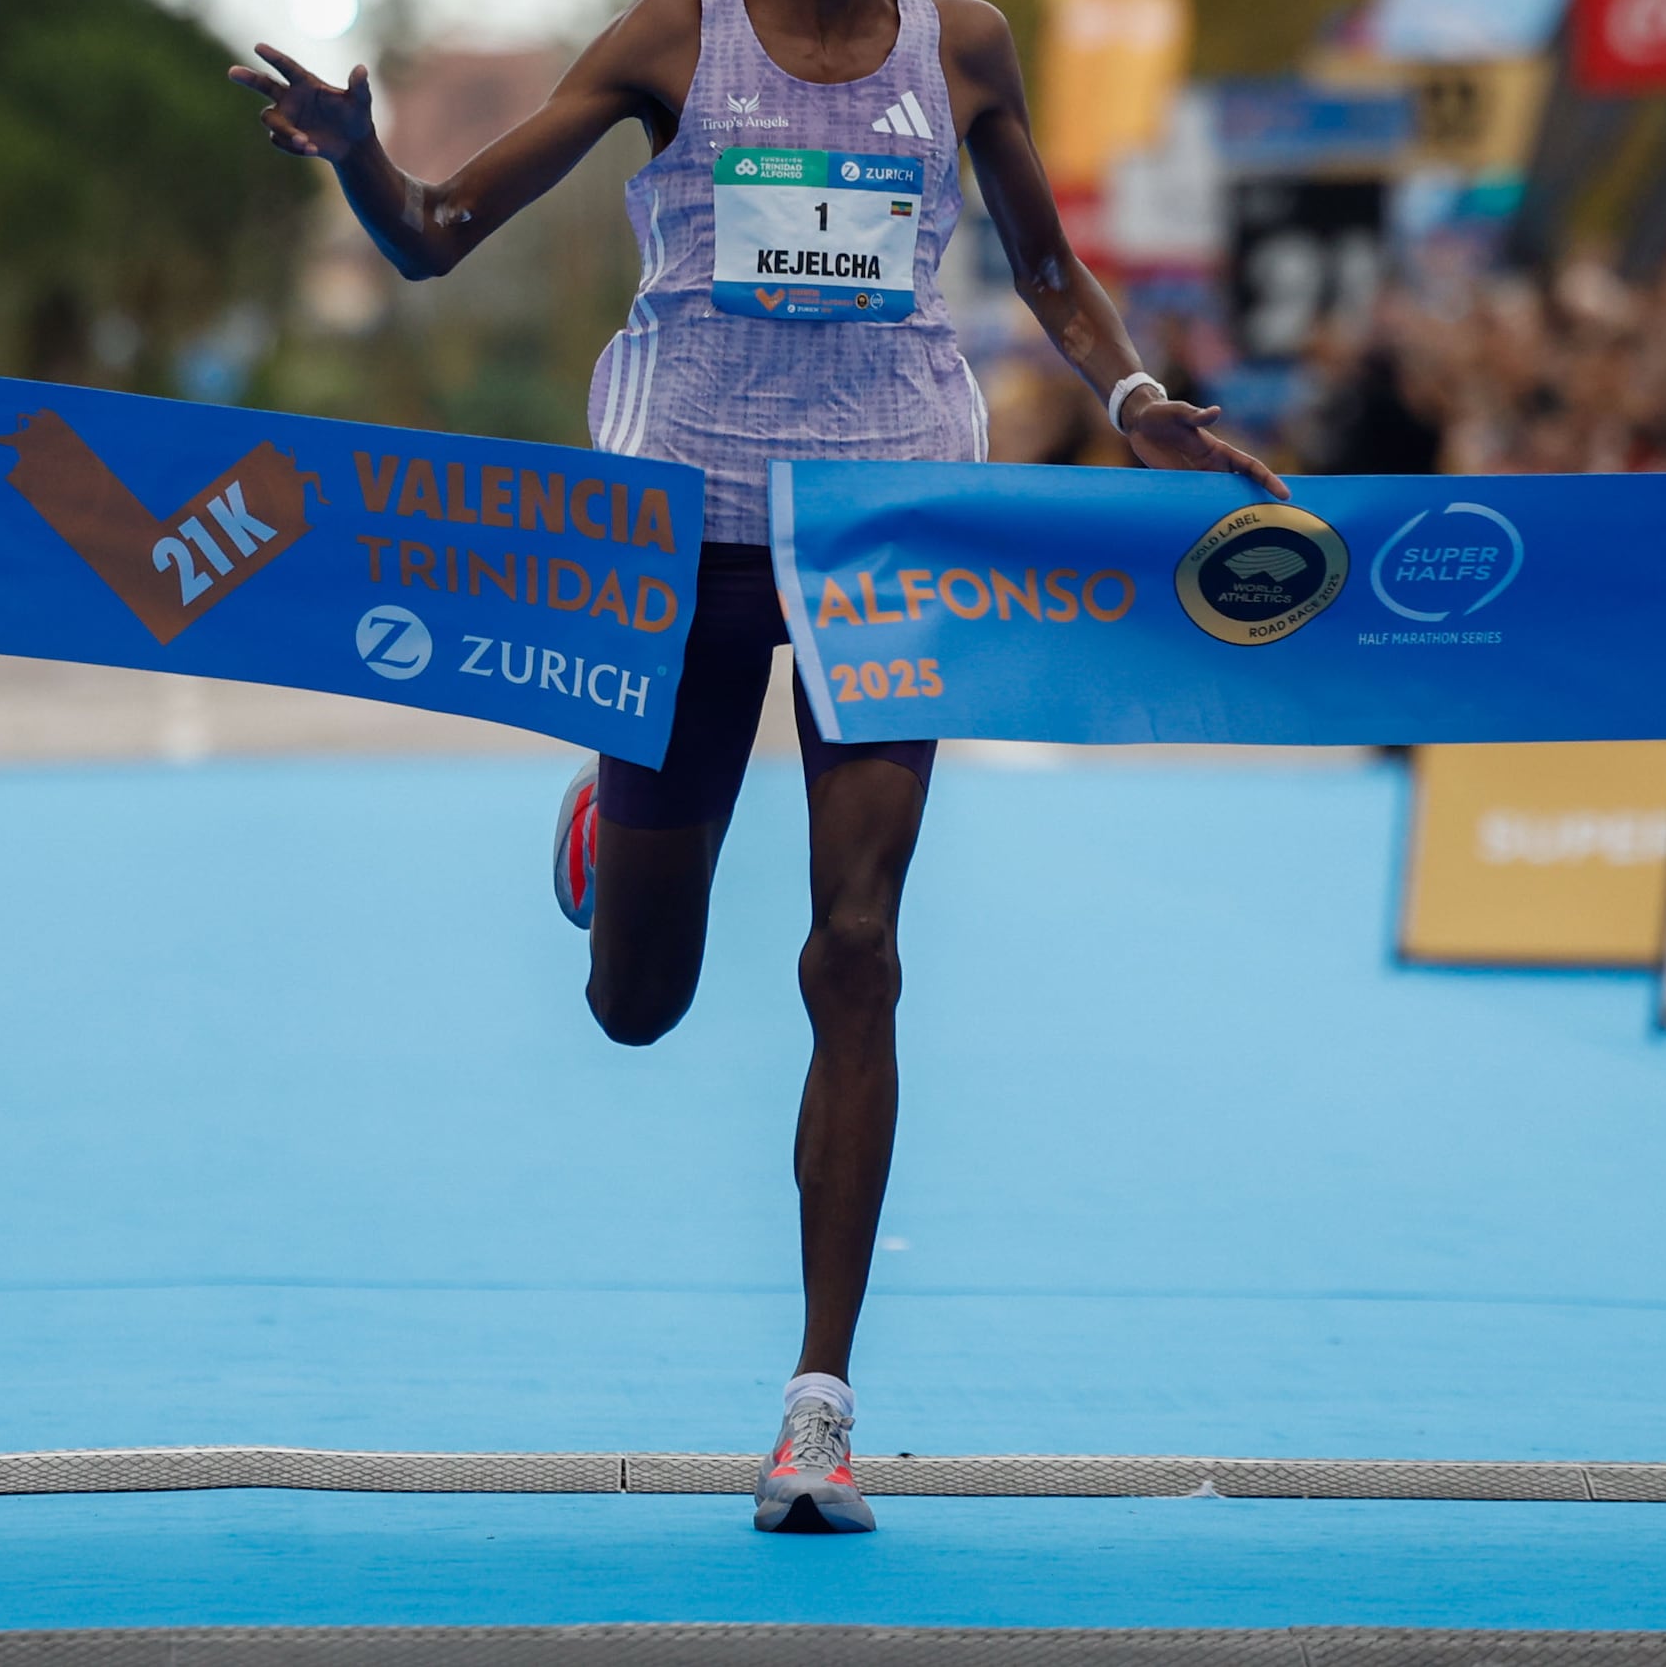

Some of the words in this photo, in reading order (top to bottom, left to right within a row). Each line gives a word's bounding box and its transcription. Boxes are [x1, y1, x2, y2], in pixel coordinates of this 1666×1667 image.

[701, 116, 743, 132] Tirop's
[745, 115, 789, 130] Angels
[760, 163, 803, 172] TRINIDAD
[760, 171, 803, 179] ALFONSO
[865, 167, 914, 182] ZURICH
[815, 202, 828, 231] 1
[757, 249, 881, 280] KEJELCHA
[352, 450, 677, 555] VALENCIA
[152, 479, 278, 607] 21K
[1189, 535, 1219, 564] GOLD
[1217, 512, 1262, 542] LABEL
[1402, 547, 1499, 563] SUPER
[355, 535, 679, 634] TRINIDAD
[1233, 582, 1283, 595] WORLD
[1395, 566, 1493, 582] HALFS
[816, 568, 1136, 628] ALFONSO
[1217, 591, 1292, 605] ATHLETICS
[1248, 619, 1286, 639] ROAD
[1286, 596, 1321, 626] RACE
[1317, 572, 1342, 602] 2025
[1358, 632, 1389, 646] HALF
[1390, 632, 1459, 645] MARATHON
[1461, 631, 1502, 644] SERIES
[459, 635, 653, 718] ZURICH
[830, 658, 944, 702] 2025
